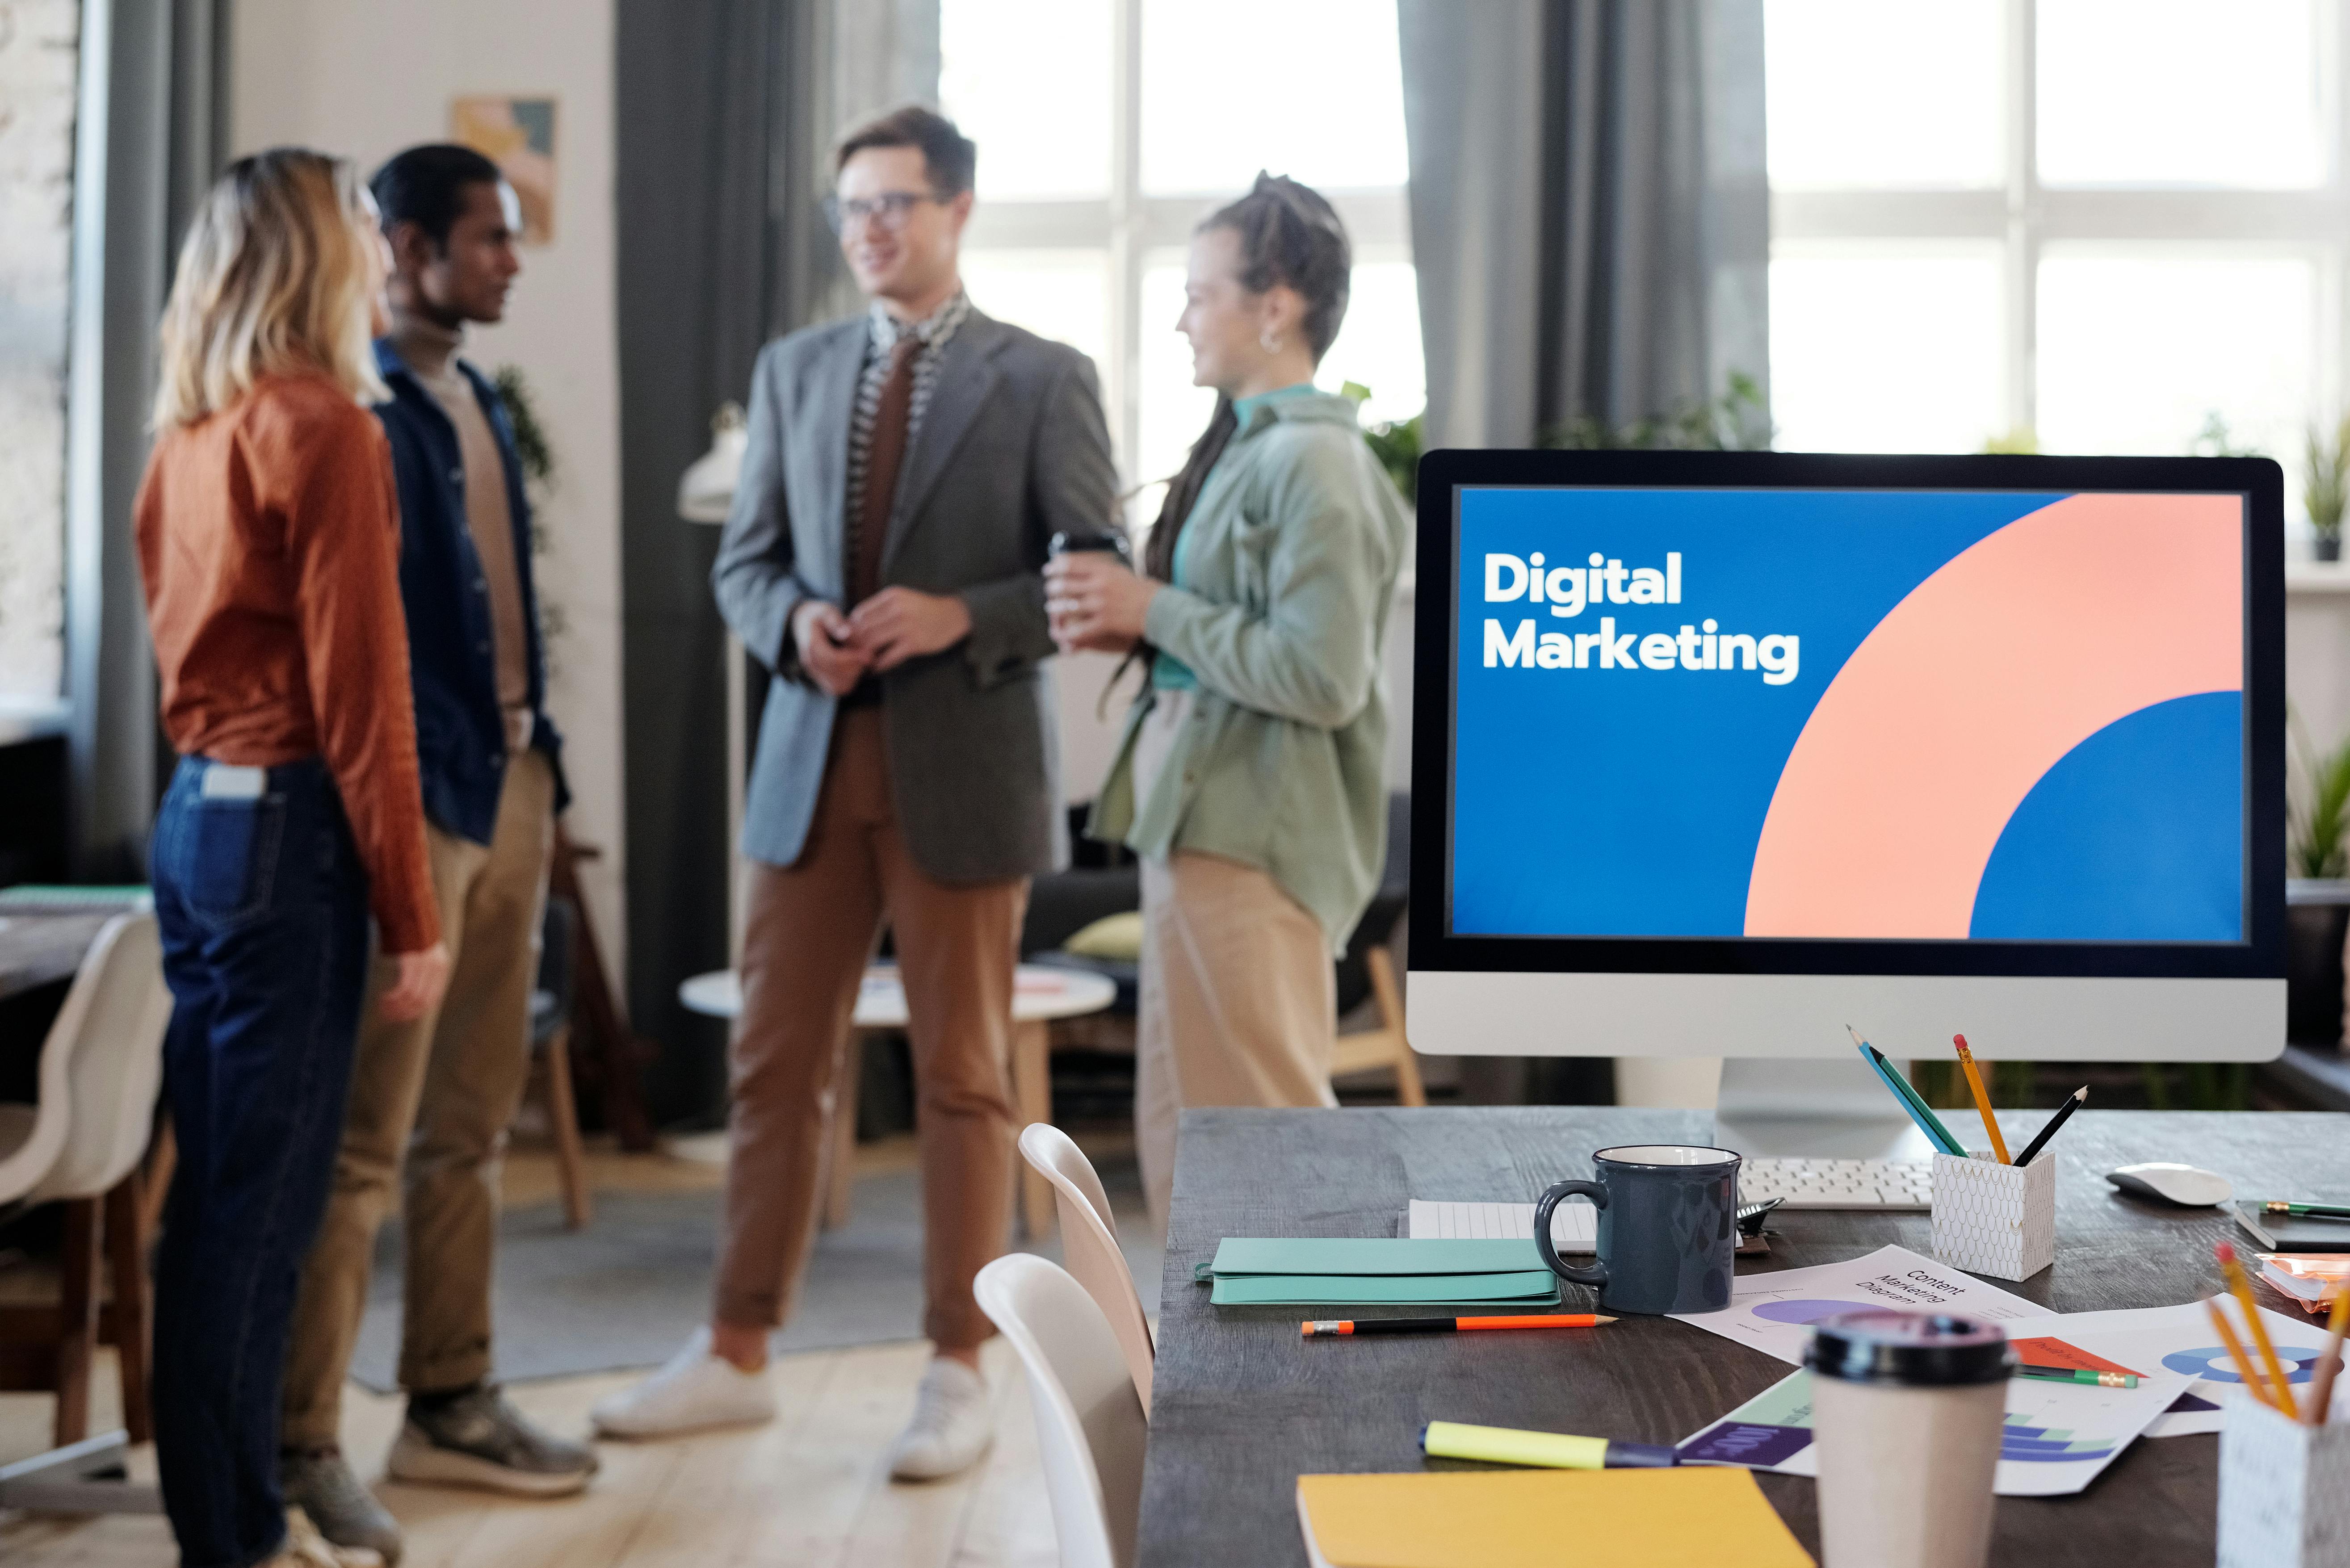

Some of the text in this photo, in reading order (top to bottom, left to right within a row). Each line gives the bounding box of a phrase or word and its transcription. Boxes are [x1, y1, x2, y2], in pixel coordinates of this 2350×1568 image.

[1484, 552, 1682, 618] Digital
[1483, 617, 1800, 685] Marketing
[1855, 1282, 1916, 1304] Diagram
[1875, 1275, 1947, 1303] Marketing
[1907, 1270, 1966, 1295] Content
